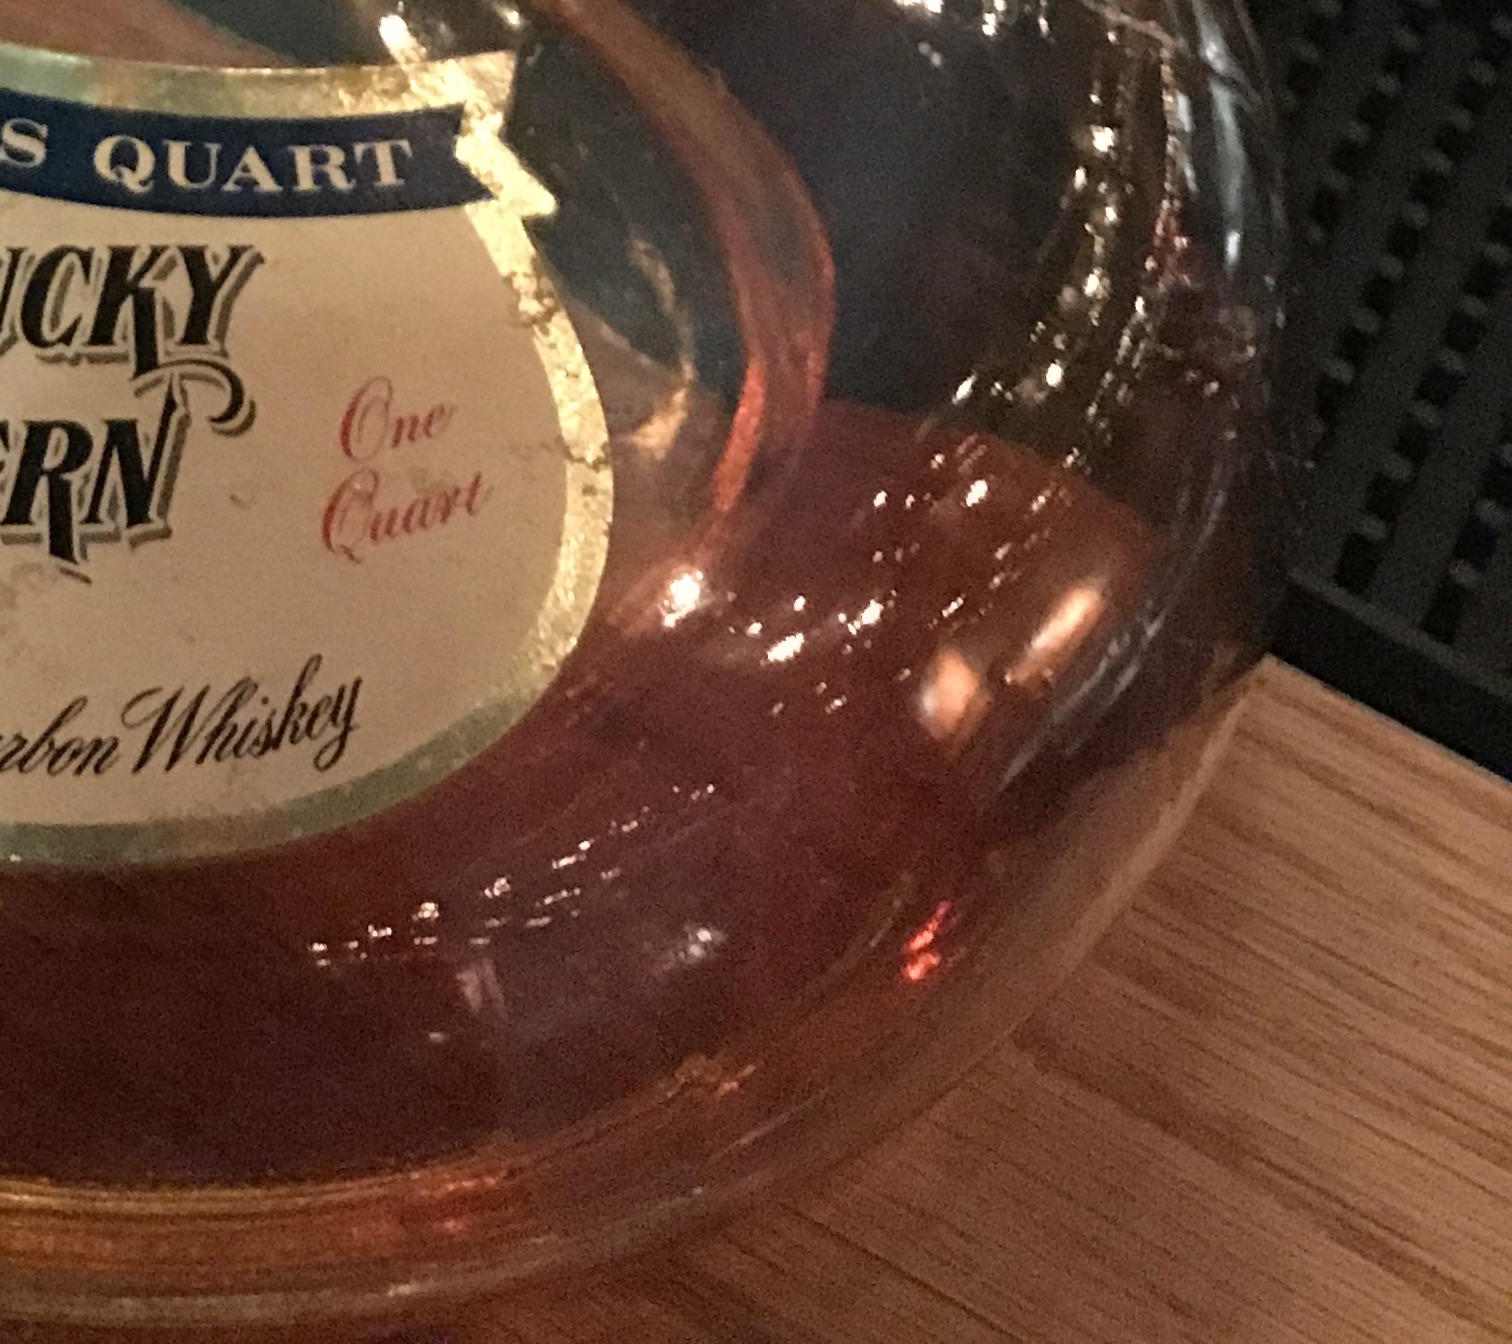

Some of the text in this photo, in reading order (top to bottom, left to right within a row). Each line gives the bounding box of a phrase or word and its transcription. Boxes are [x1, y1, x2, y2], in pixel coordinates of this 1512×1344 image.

[92, 133, 414, 195] QUART
[340, 375, 458, 462] One
[321, 469, 495, 565] Quart
[121, 653, 363, 775] Whiskey
